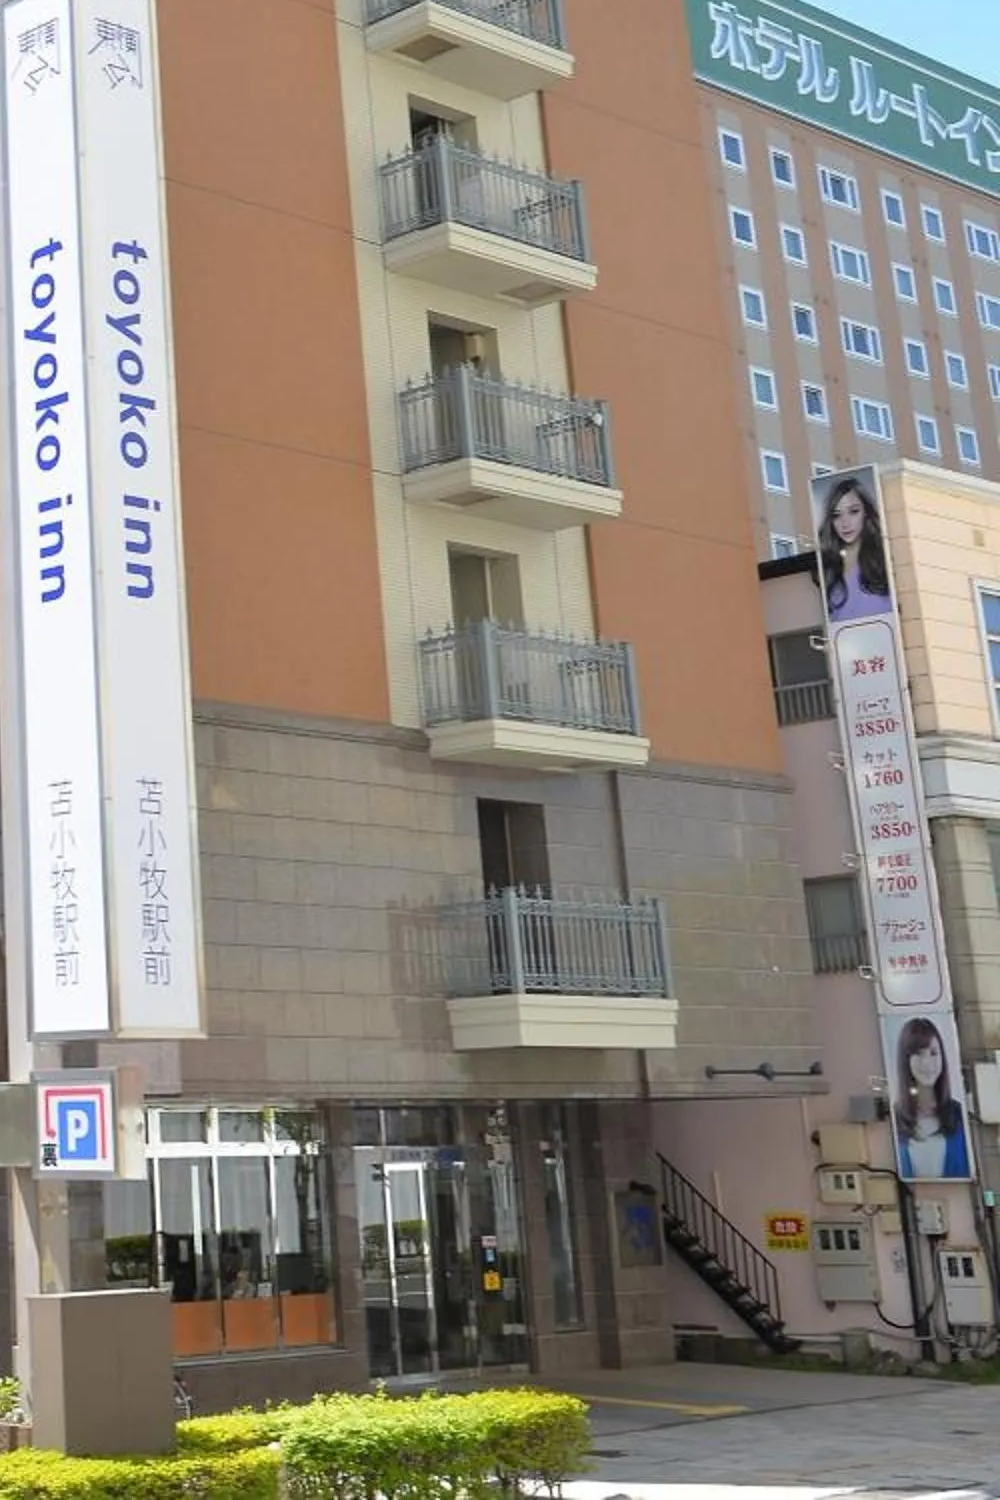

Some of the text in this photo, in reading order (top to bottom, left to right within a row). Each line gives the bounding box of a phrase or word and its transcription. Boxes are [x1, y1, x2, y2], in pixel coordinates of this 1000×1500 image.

[707, 0, 840, 102] ホテル
[23, 238, 72, 603] toyoko inn
[105, 239, 160, 599] toyoko inn
[862, 749, 898, 764] カット
[864, 769, 904, 788] 1760
[48, 779, 80, 987] 苫小牧駅前
[135, 777, 172, 987] 苫小牧駅前
[876, 875, 917, 893] 7700
[67, 1109, 89, 1153] P
